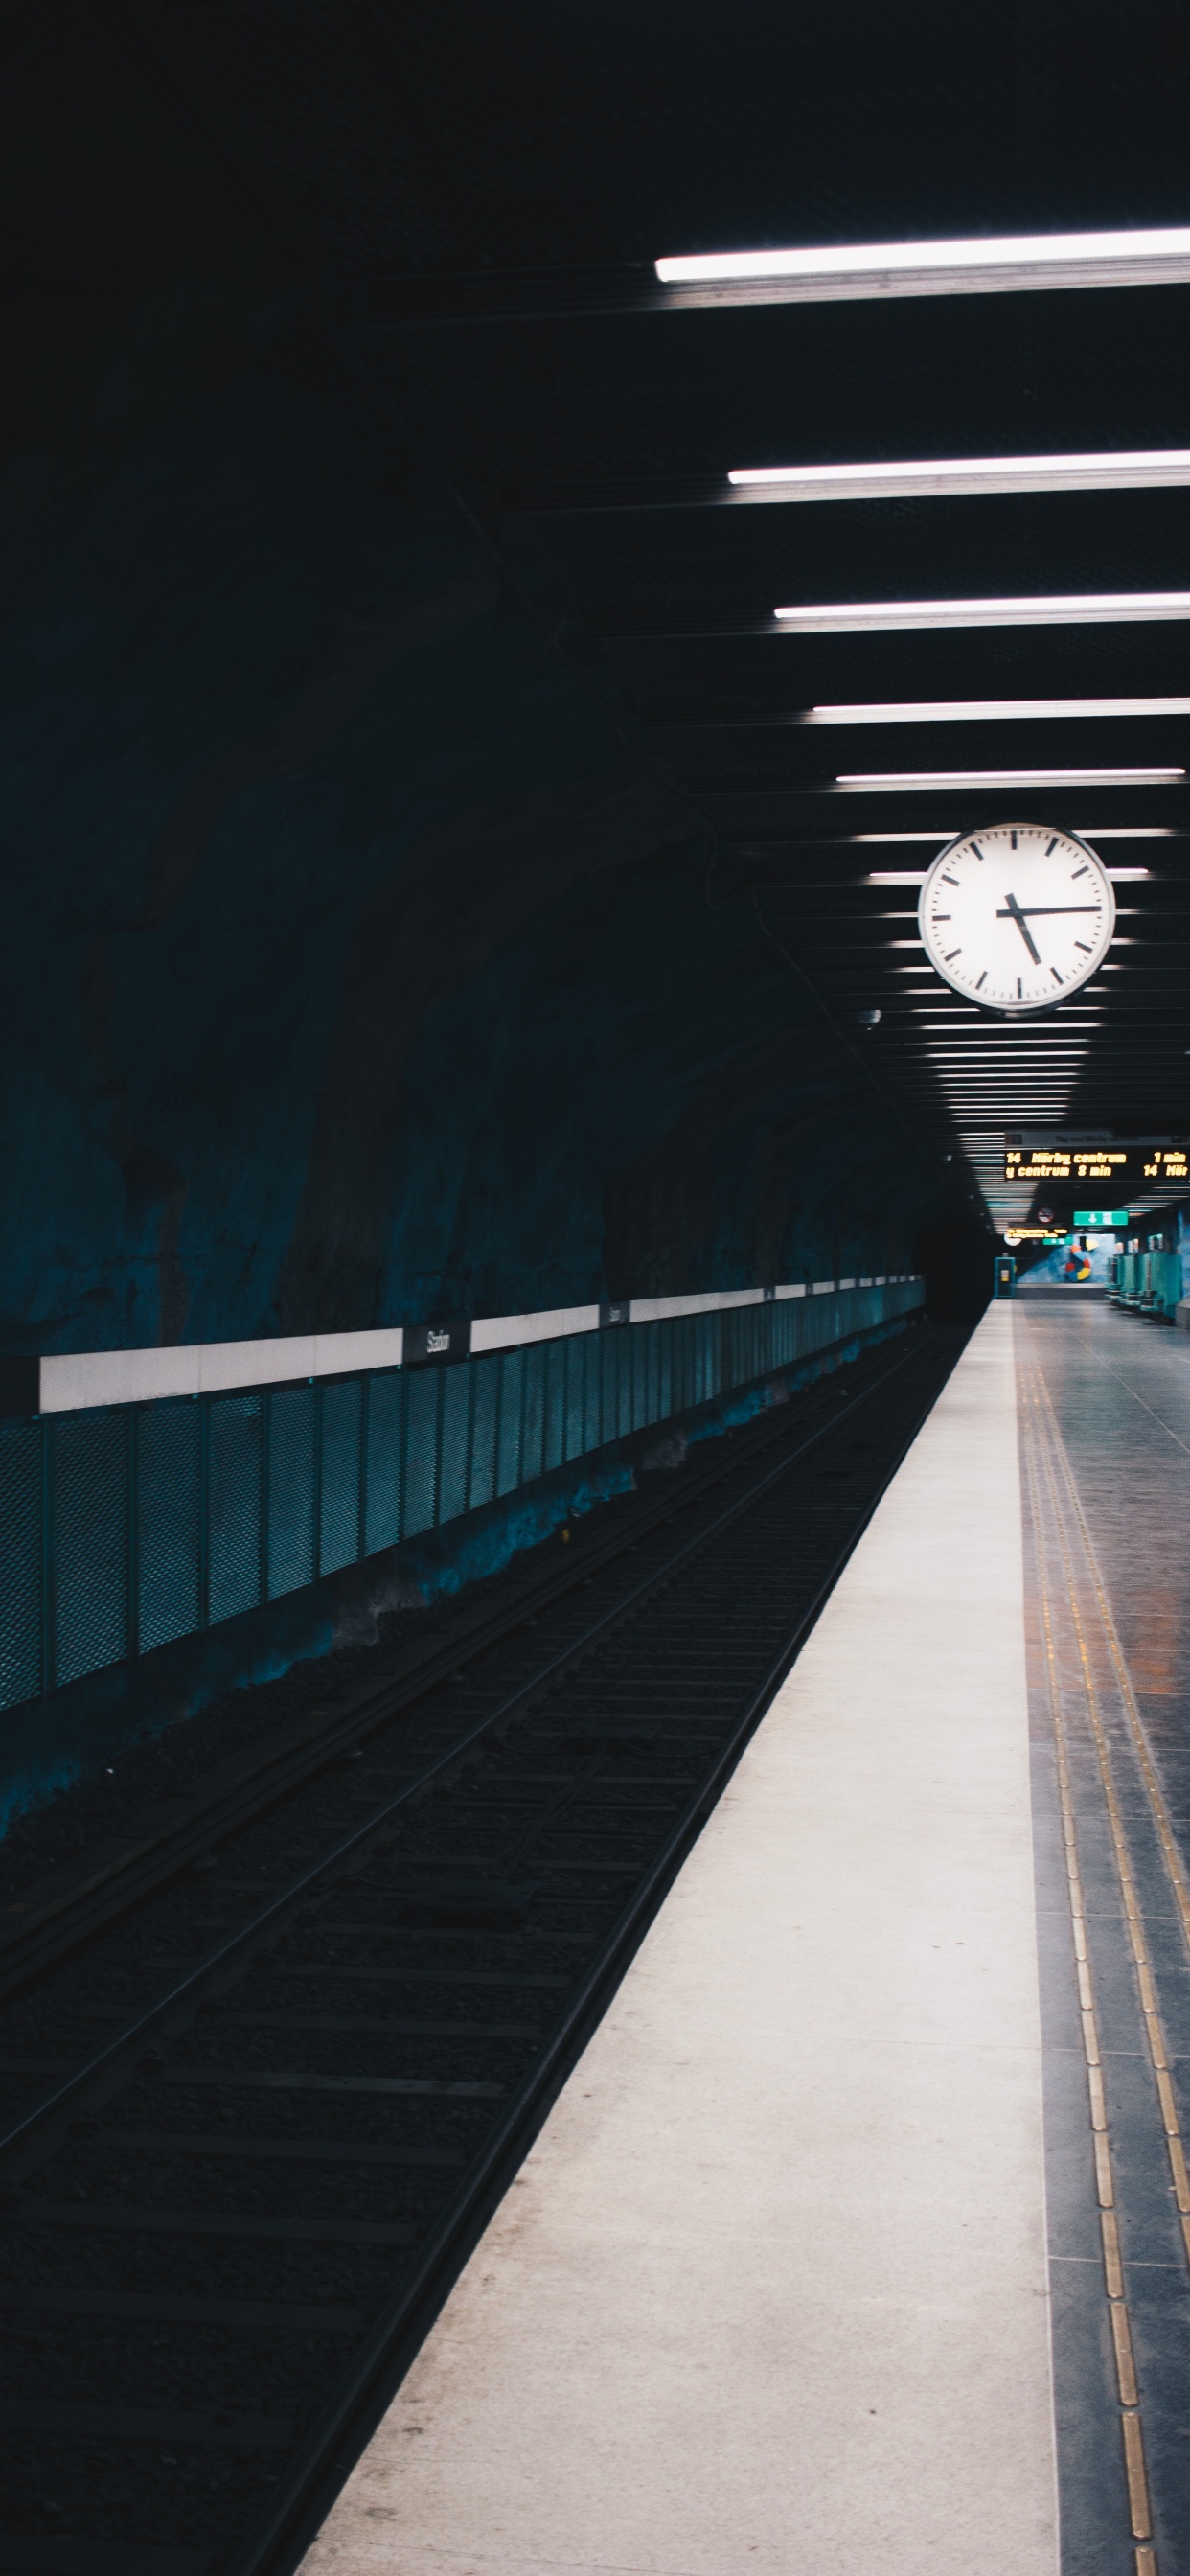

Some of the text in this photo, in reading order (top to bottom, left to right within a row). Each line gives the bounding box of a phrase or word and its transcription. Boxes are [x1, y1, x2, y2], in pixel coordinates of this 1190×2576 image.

[1006, 1152, 1021, 1163] 14
[1073, 1152, 1127, 1163] centrum
[1154, 1152, 1162, 1163] 1
[1162, 1152, 1186, 1163] min
[1006, 1166, 1015, 1178] y
[1018, 1164, 1070, 1177] centrum
[1077, 1164, 1087, 1177] 8
[1089, 1164, 1111, 1177] min
[1143, 1164, 1158, 1177] 14
